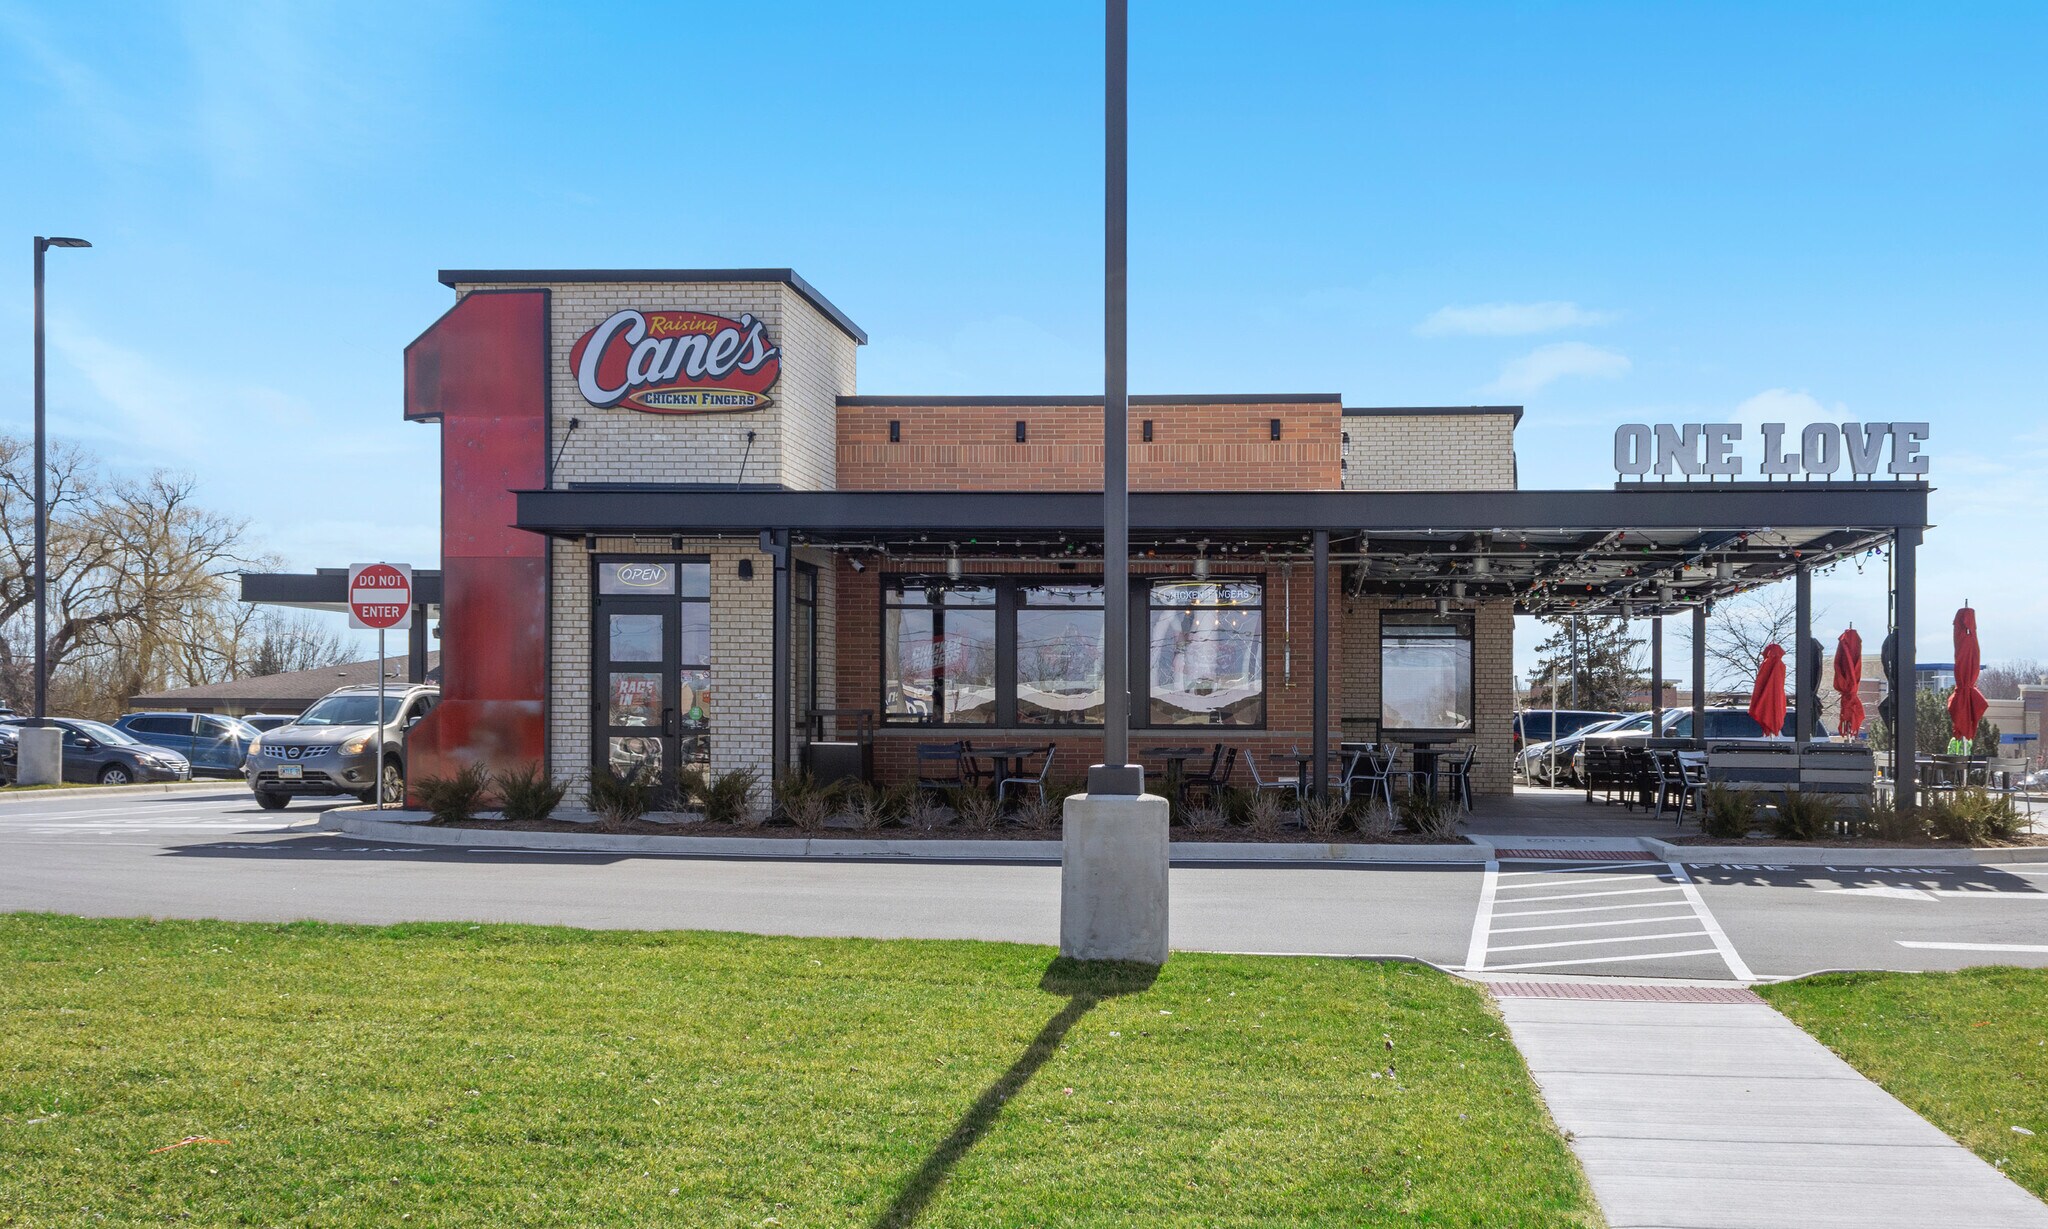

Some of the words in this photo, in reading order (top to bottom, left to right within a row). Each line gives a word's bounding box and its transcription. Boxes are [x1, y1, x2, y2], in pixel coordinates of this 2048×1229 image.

[649, 315, 718, 335] Raising
[578, 308, 777, 405] Cane's
[644, 392, 698, 405] CHICKEN
[701, 392, 756, 405] FINGERS
[1614, 423, 1742, 475] ONE
[1760, 422, 1929, 475] LOVE
[360, 575, 375, 586] DO
[379, 575, 402, 586] NOT
[621, 567, 661, 581] OPEN
[362, 606, 399, 617] ENTER
[1688, 863, 1796, 872] FIRE
[1824, 866, 1955, 875] LANE
